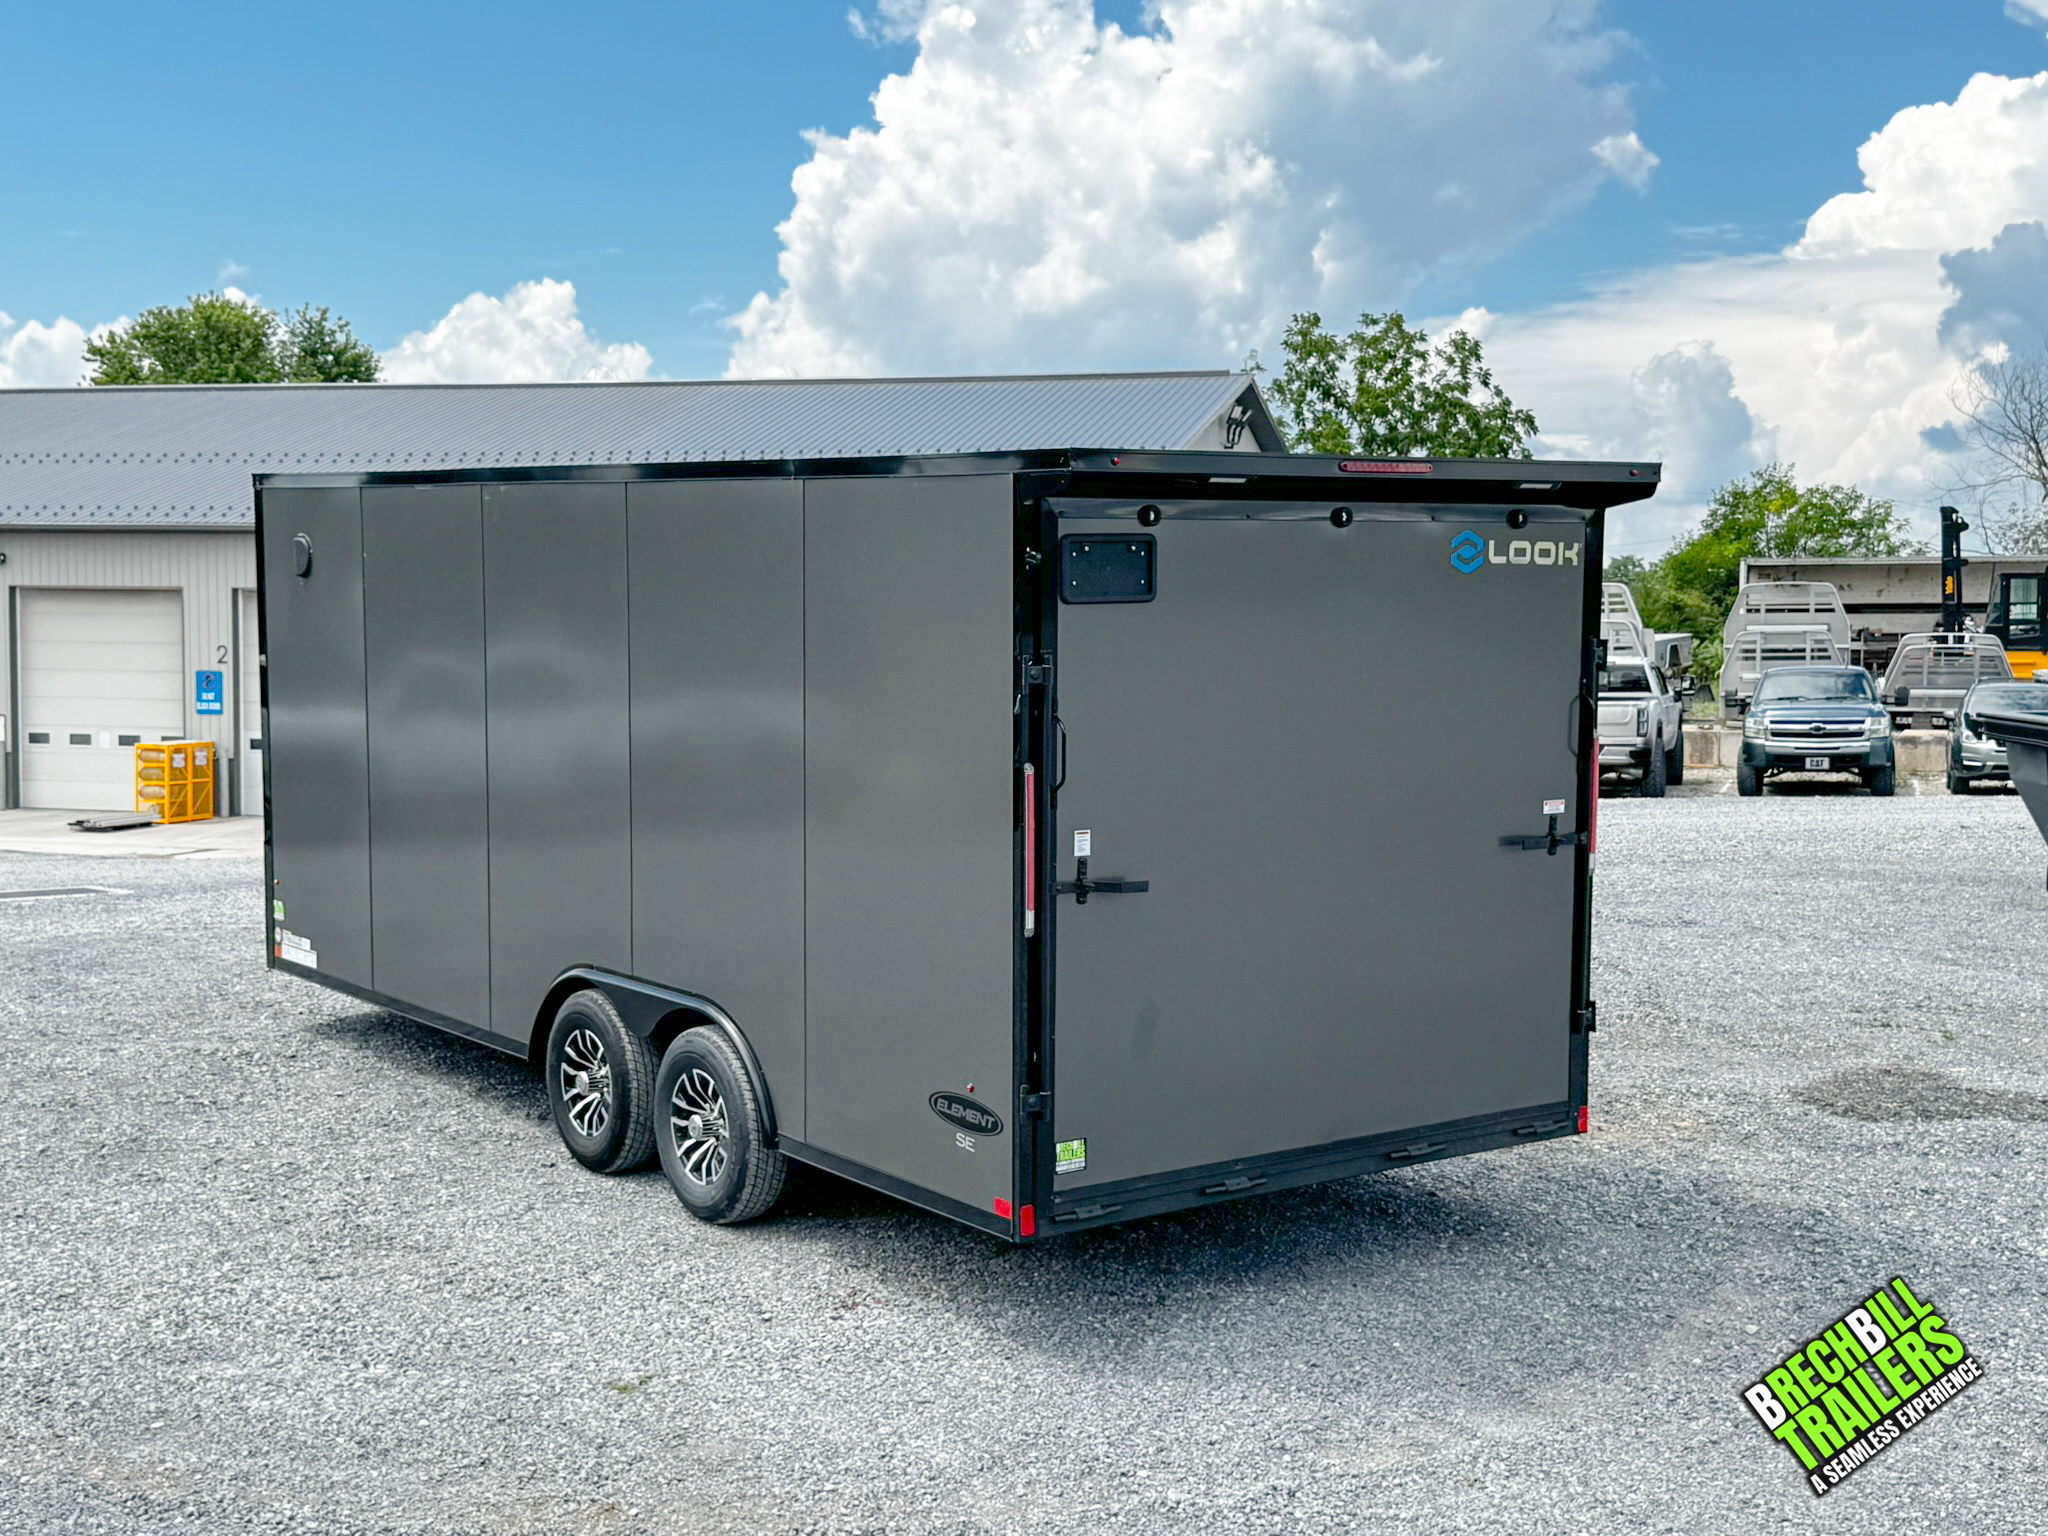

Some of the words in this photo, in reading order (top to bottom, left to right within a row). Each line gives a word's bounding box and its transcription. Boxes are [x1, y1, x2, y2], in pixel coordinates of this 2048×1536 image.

[1488, 540, 1579, 566] LOOK
[217, 644, 228, 664] 2
[1810, 759, 1825, 768] CAT
[936, 1098, 996, 1129] ELEMENT
[955, 1132, 976, 1153] SE
